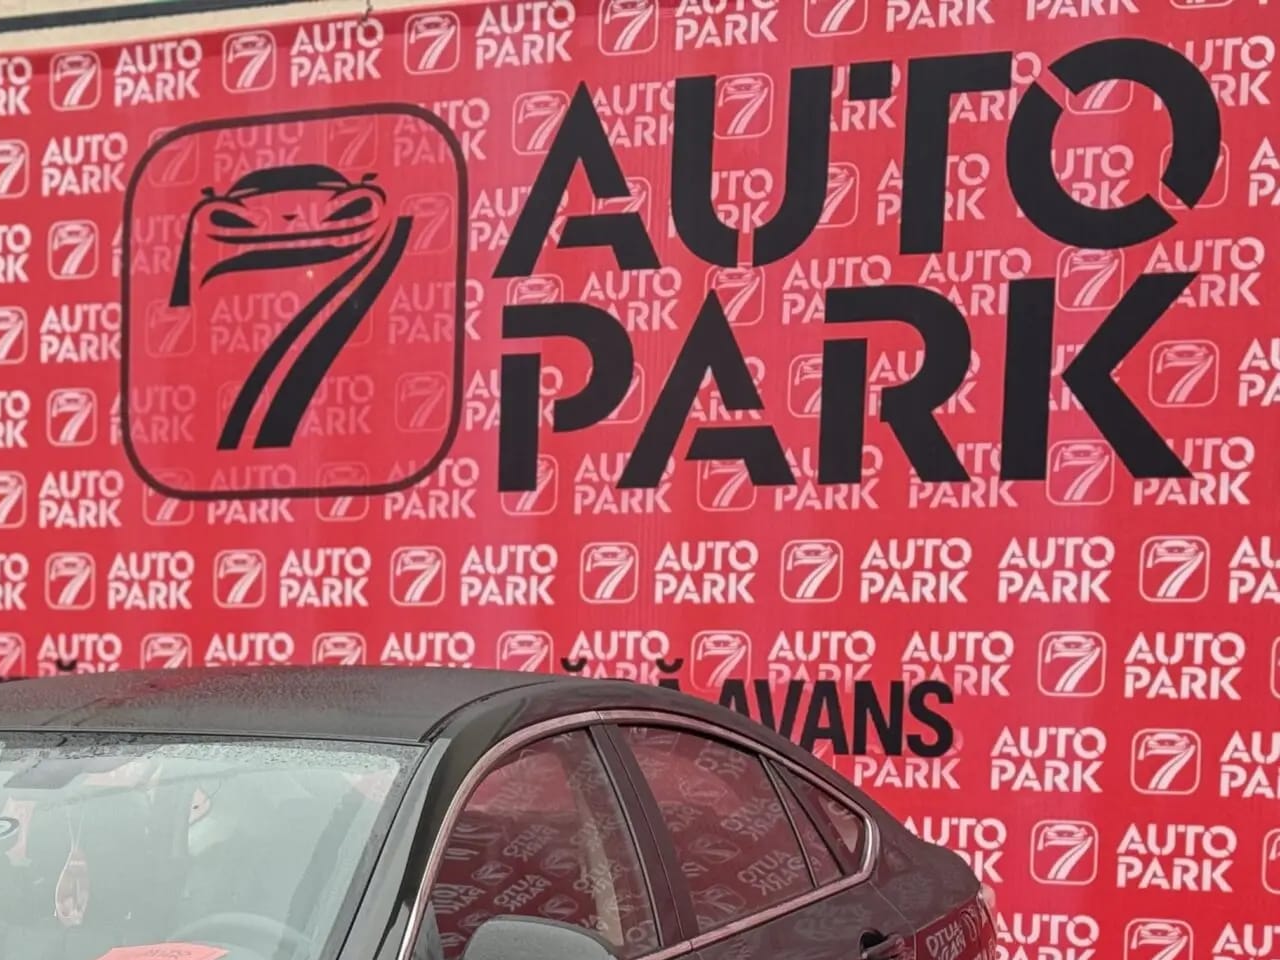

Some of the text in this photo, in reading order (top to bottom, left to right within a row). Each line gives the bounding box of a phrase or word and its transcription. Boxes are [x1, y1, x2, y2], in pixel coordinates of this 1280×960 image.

[475, 0, 576, 40] AUTO
[675, 9, 778, 50] PARK
[885, 0, 995, 32] PARK
[114, 39, 202, 75] AUTO
[290, 23, 384, 58] AUTO
[476, 31, 573, 69] PARK
[1169, 35, 1275, 71] UTO
[290, 52, 382, 87] PARK
[114, 70, 200, 106] PARK
[42, 133, 128, 166] AUTO
[492, 37, 1222, 278] AUTO
[42, 163, 126, 196] PARK
[918, 248, 1032, 284] AUTO
[1143, 237, 1265, 274] AUTO
[581, 266, 682, 299] AUTO
[782, 255, 892, 290] AUTO
[40, 302, 122, 333] AUTO
[40, 332, 120, 363] PARK
[498, 272, 1200, 492] PARK
[39, 470, 124, 498] AUTO
[573, 485, 672, 515] PARK
[774, 478, 879, 511] PARK
[909, 478, 1018, 510] PARK
[1132, 472, 1253, 506] PARK
[39, 500, 122, 528] PARK
[208, 497, 294, 524] PARK
[384, 488, 476, 520] PARK
[108, 551, 194, 579] AUTO
[280, 547, 371, 576] AUTO
[461, 544, 557, 573] AUTO
[655, 540, 758, 570] AUTO
[861, 538, 971, 569] AUTO
[999, 536, 1115, 568] AUTO
[108, 581, 192, 609] PARK
[280, 578, 369, 607] PARK
[461, 576, 555, 605] PARK
[655, 573, 756, 603] PARK
[861, 571, 969, 602] PARK
[999, 570, 1113, 602] PARK
[37, 633, 122, 661] AUTO
[206, 632, 294, 661] AUTO
[381, 631, 475, 661] AUTO
[568, 630, 670, 662] AUTO
[768, 630, 876, 662] AUTO
[902, 630, 1015, 663] AUTO
[1124, 632, 1246, 665] AUTO
[1124, 666, 1242, 700] PARK
[991, 727, 1107, 760] AUTO
[854, 757, 960, 790] PARK
[992, 759, 1104, 793] PARK
[1116, 823, 1238, 859] AUTO
[1116, 856, 1234, 893] PARK
[995, 912, 1100, 947] AUTO
